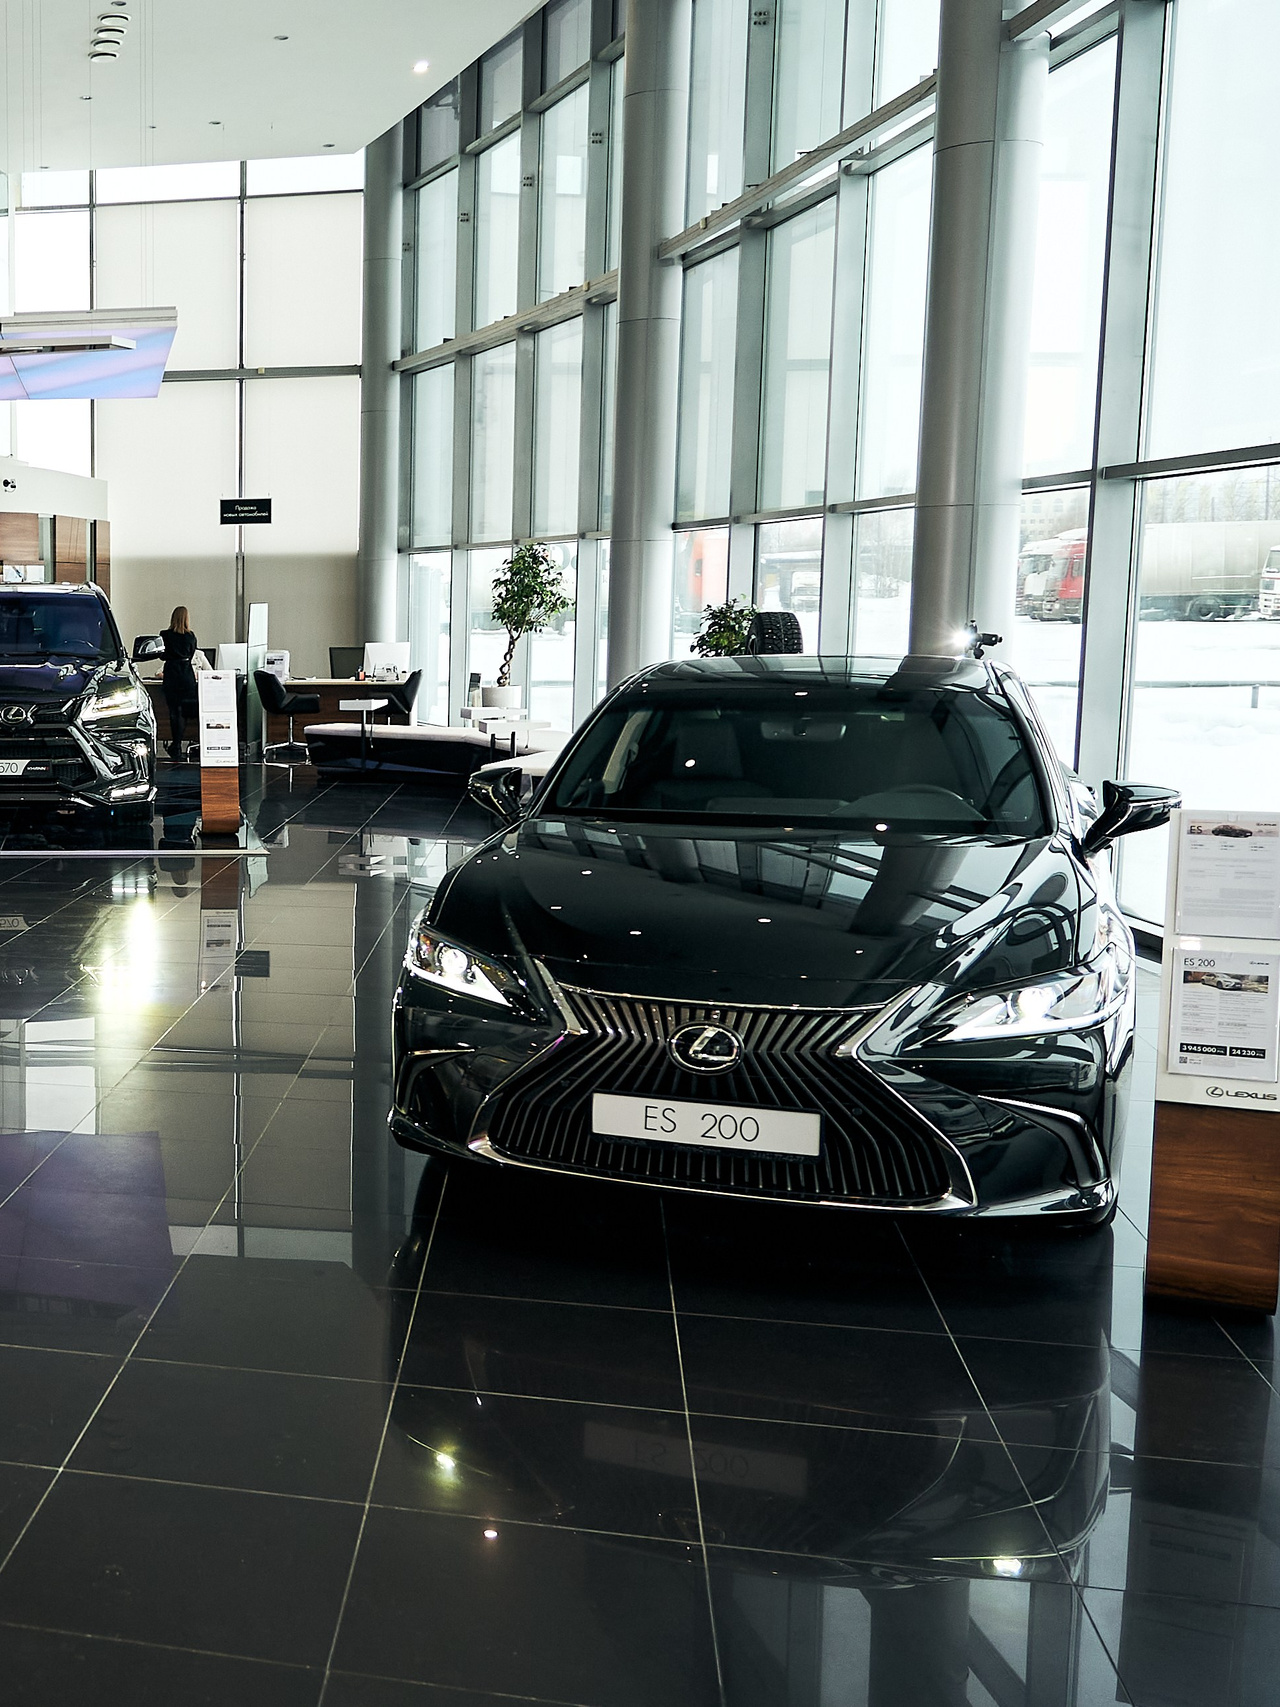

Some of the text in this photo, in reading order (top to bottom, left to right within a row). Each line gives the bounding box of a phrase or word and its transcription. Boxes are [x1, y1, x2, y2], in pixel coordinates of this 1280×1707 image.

[234, 504, 257, 512] Продажа
[1189, 825, 1203, 834] ES
[1183, 957, 1216, 968] ES 200
[1226, 1090, 1277, 1101] LEXUS
[644, 1105, 760, 1142] ES 200
